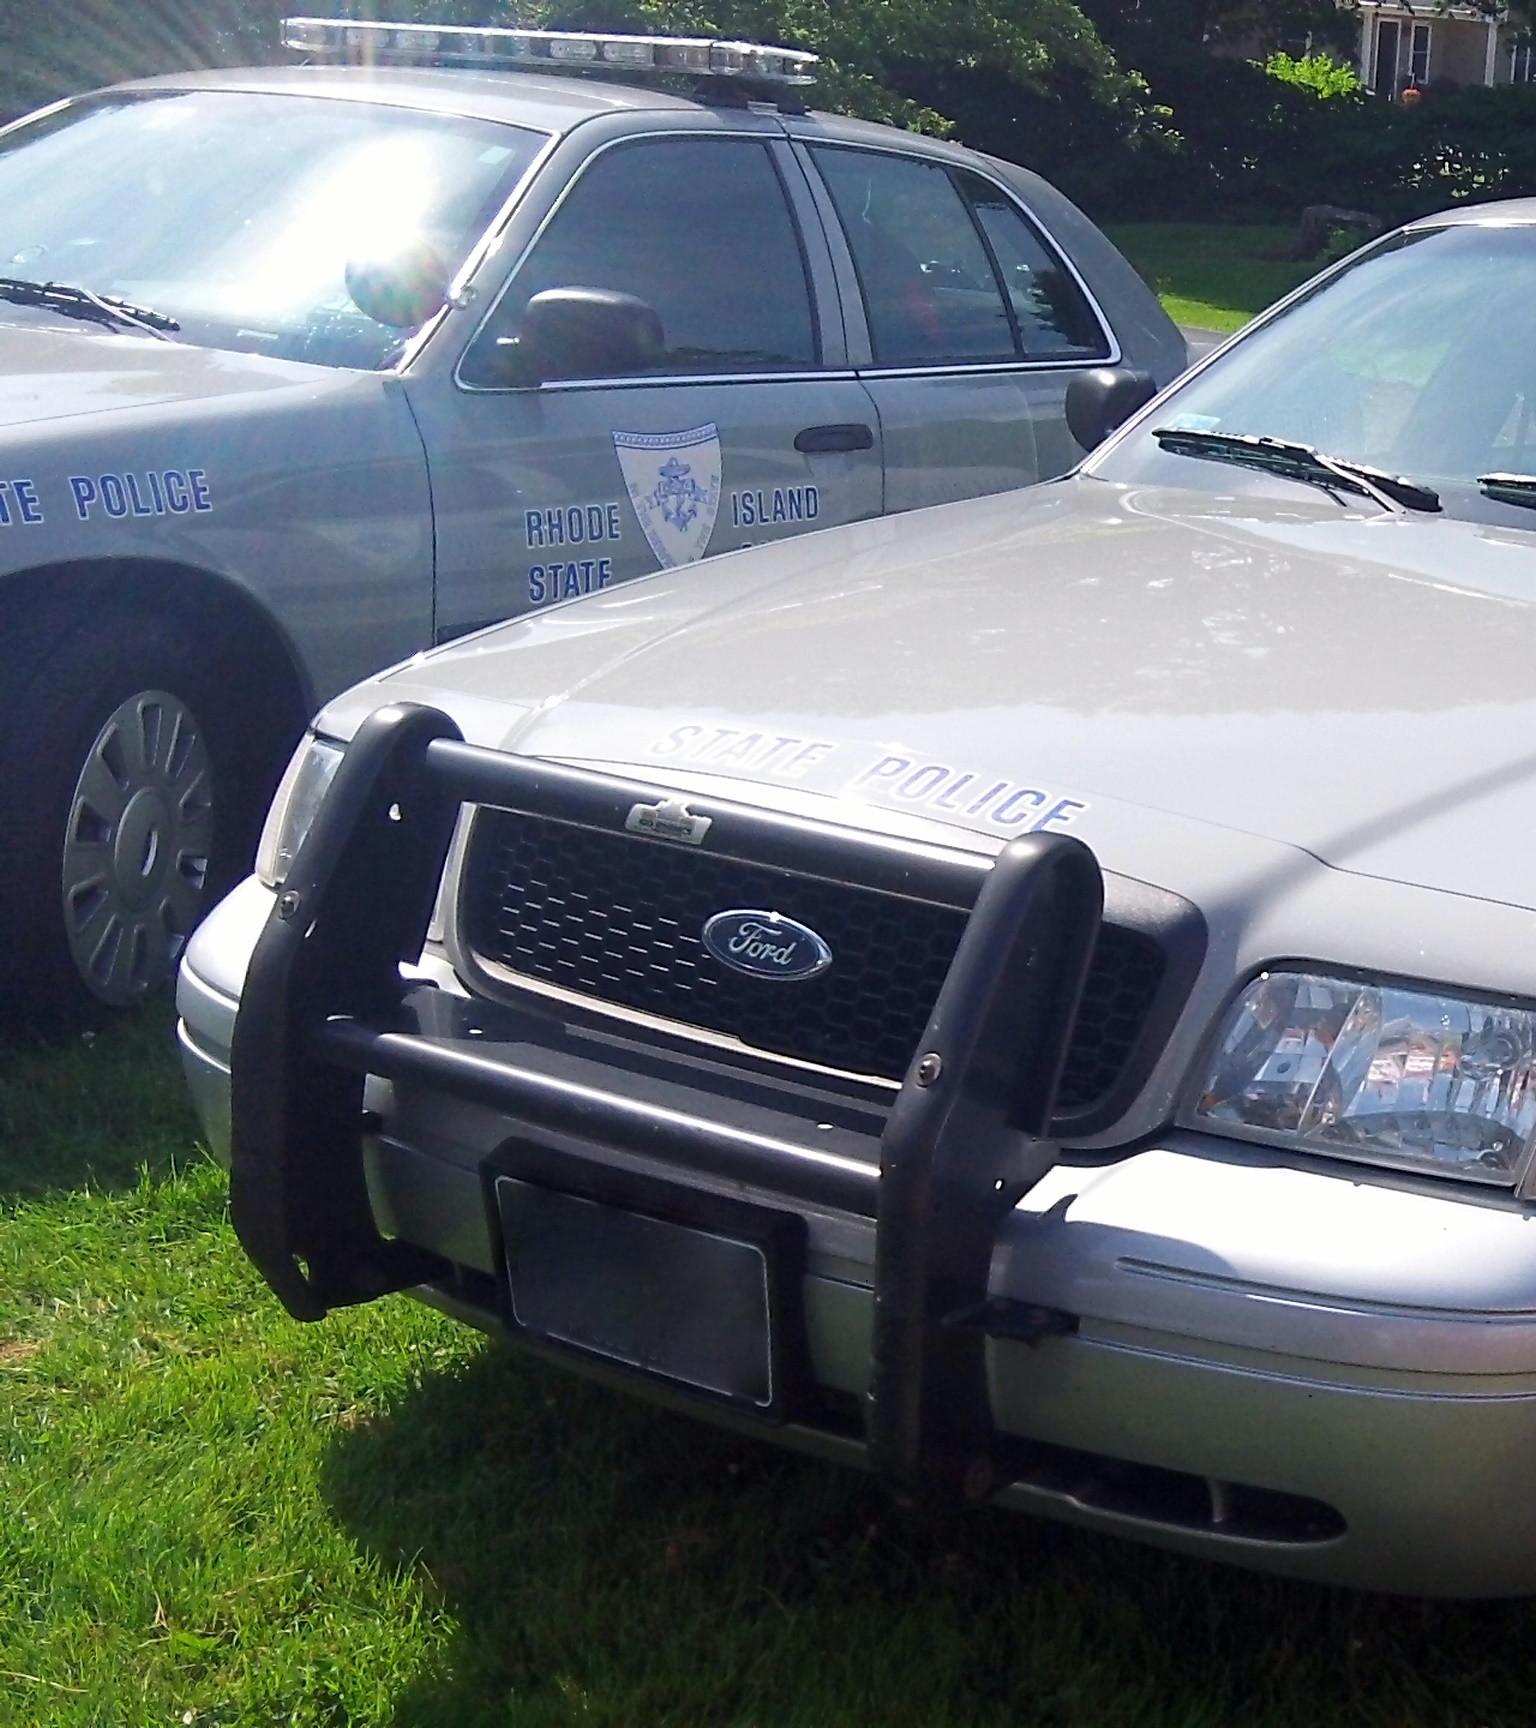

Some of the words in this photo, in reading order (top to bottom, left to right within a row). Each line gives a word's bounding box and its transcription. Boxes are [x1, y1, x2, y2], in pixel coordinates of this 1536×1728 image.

[68, 469, 212, 520] POLICE
[525, 503, 621, 548] RHODE
[731, 485, 819, 528] ISLAND
[650, 722, 835, 779] STATE
[852, 754, 1088, 834] POLICE
[728, 921, 798, 966] Ford
